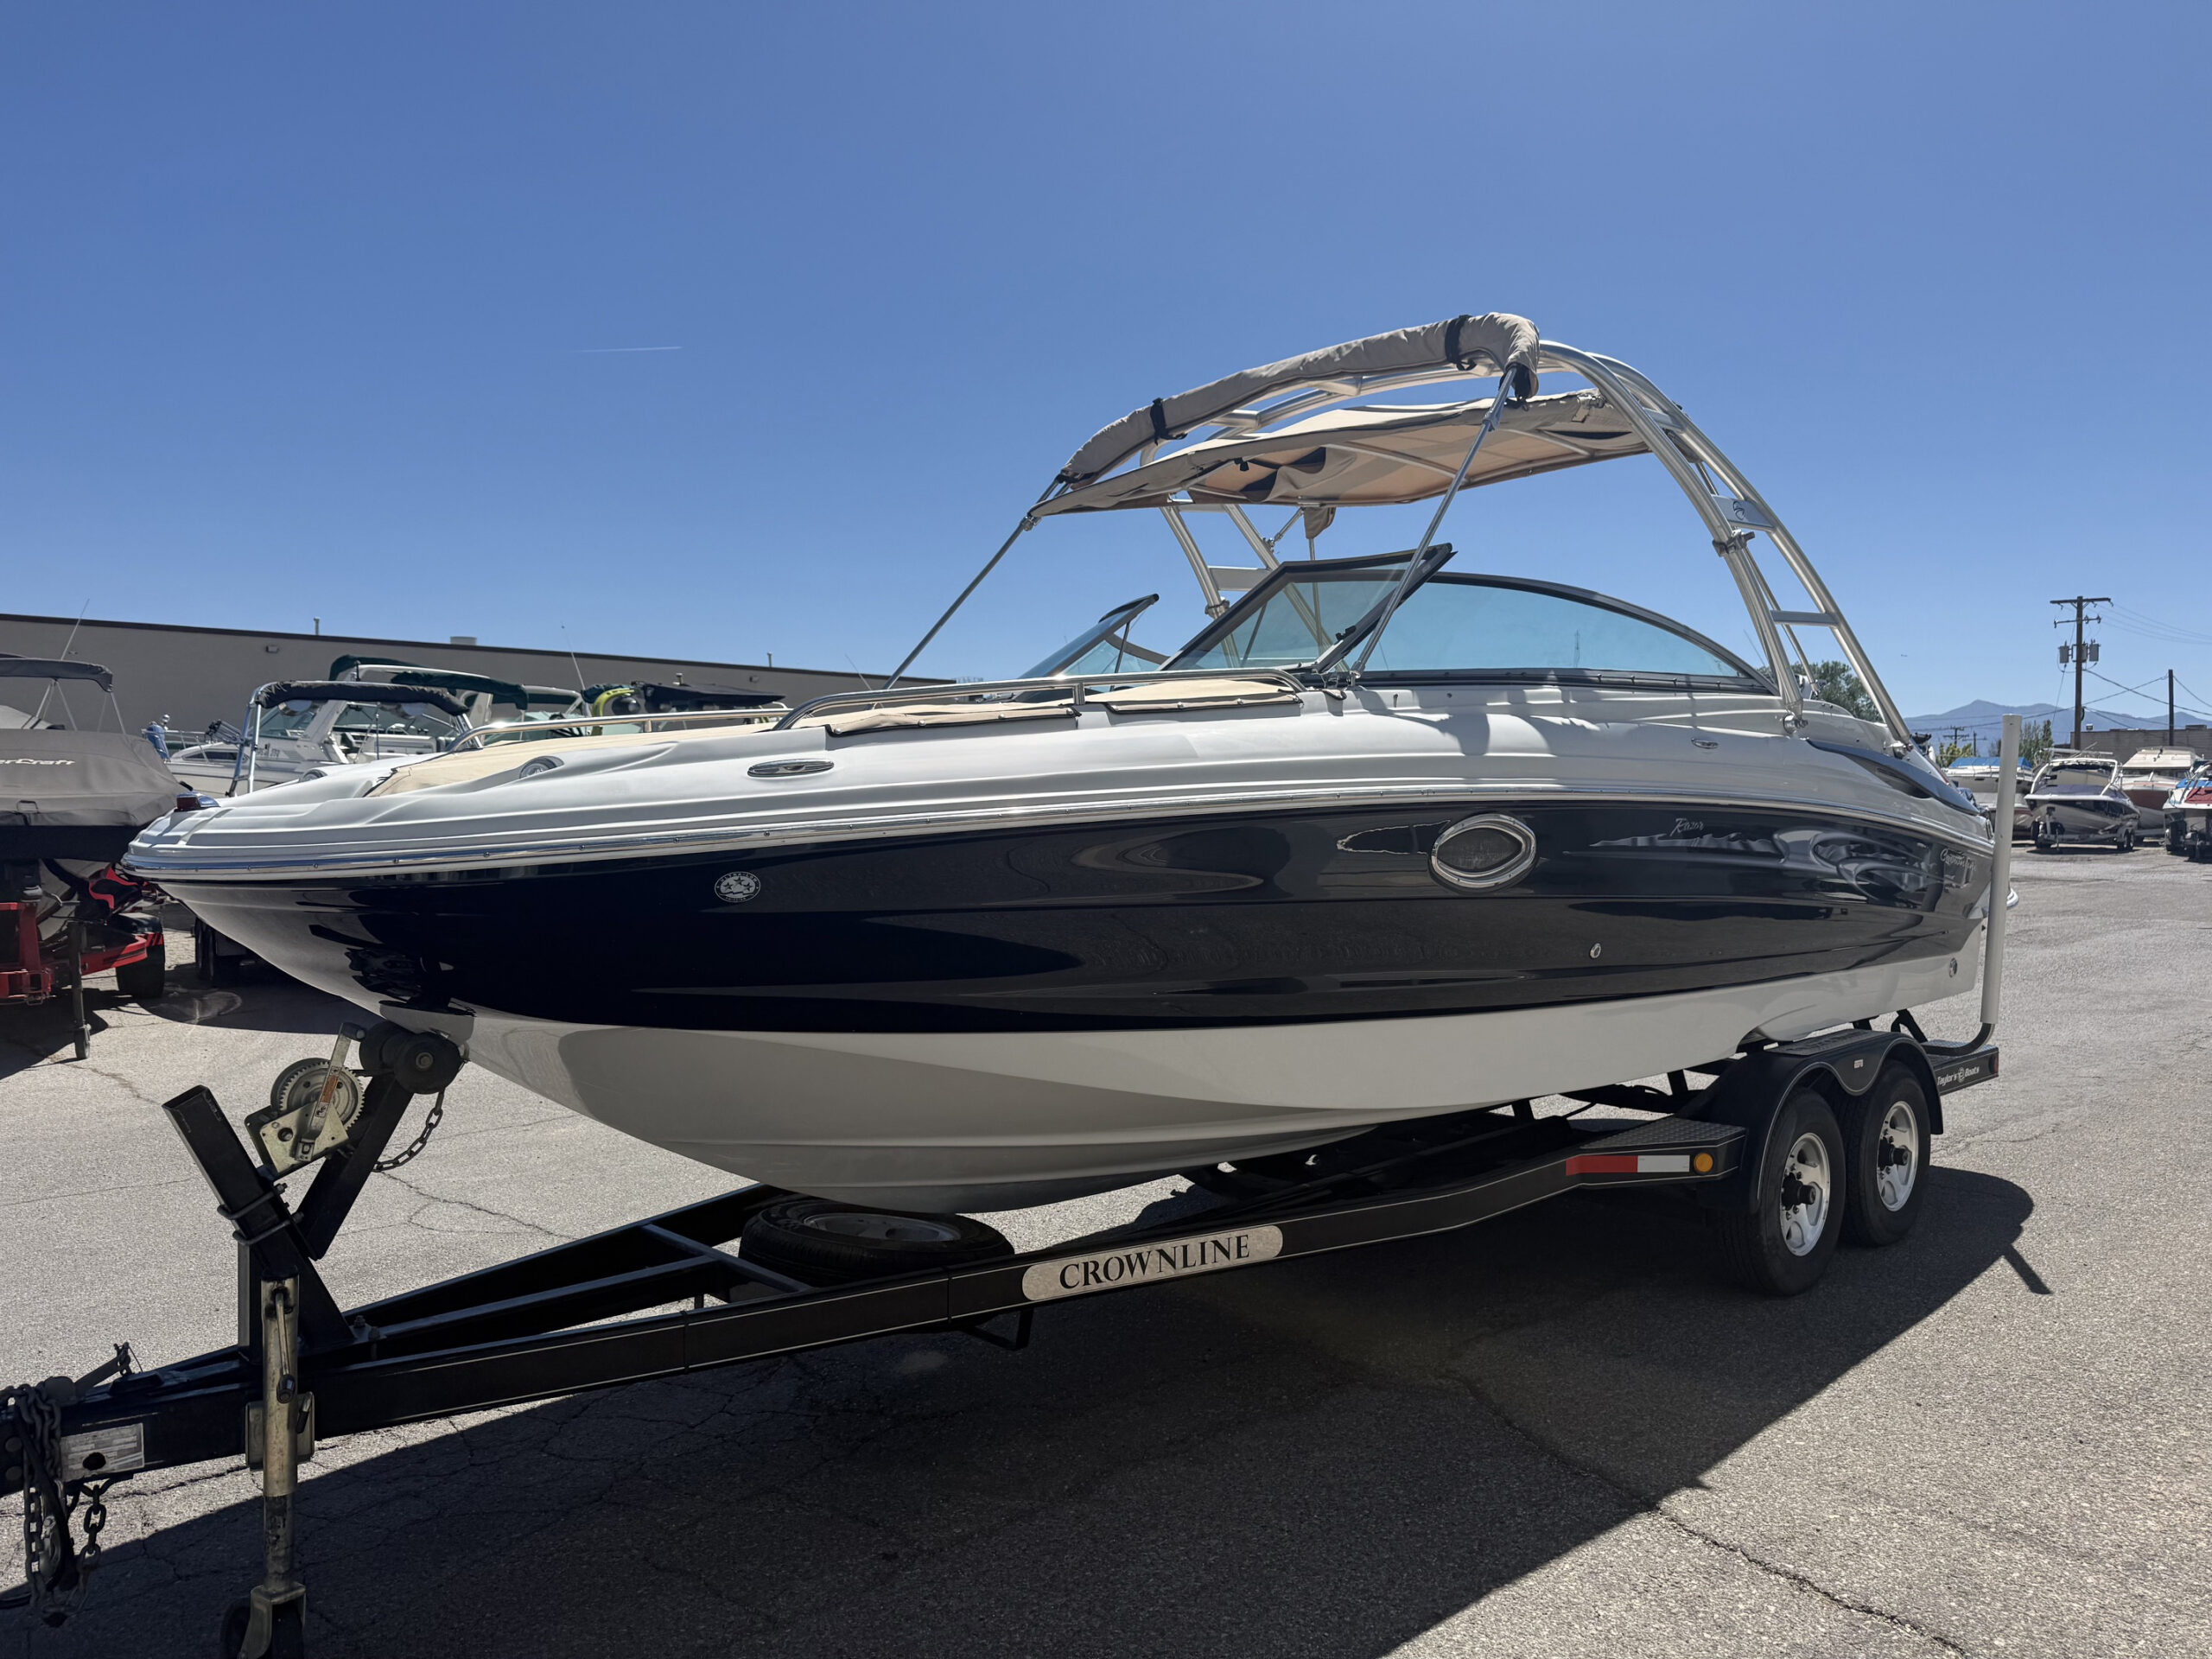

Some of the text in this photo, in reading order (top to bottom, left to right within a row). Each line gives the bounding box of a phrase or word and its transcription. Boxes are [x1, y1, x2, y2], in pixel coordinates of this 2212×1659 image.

[1936, 1065, 1980, 1087] Taylor's Boats
[1058, 1234, 1250, 1290] CROWNLINE
